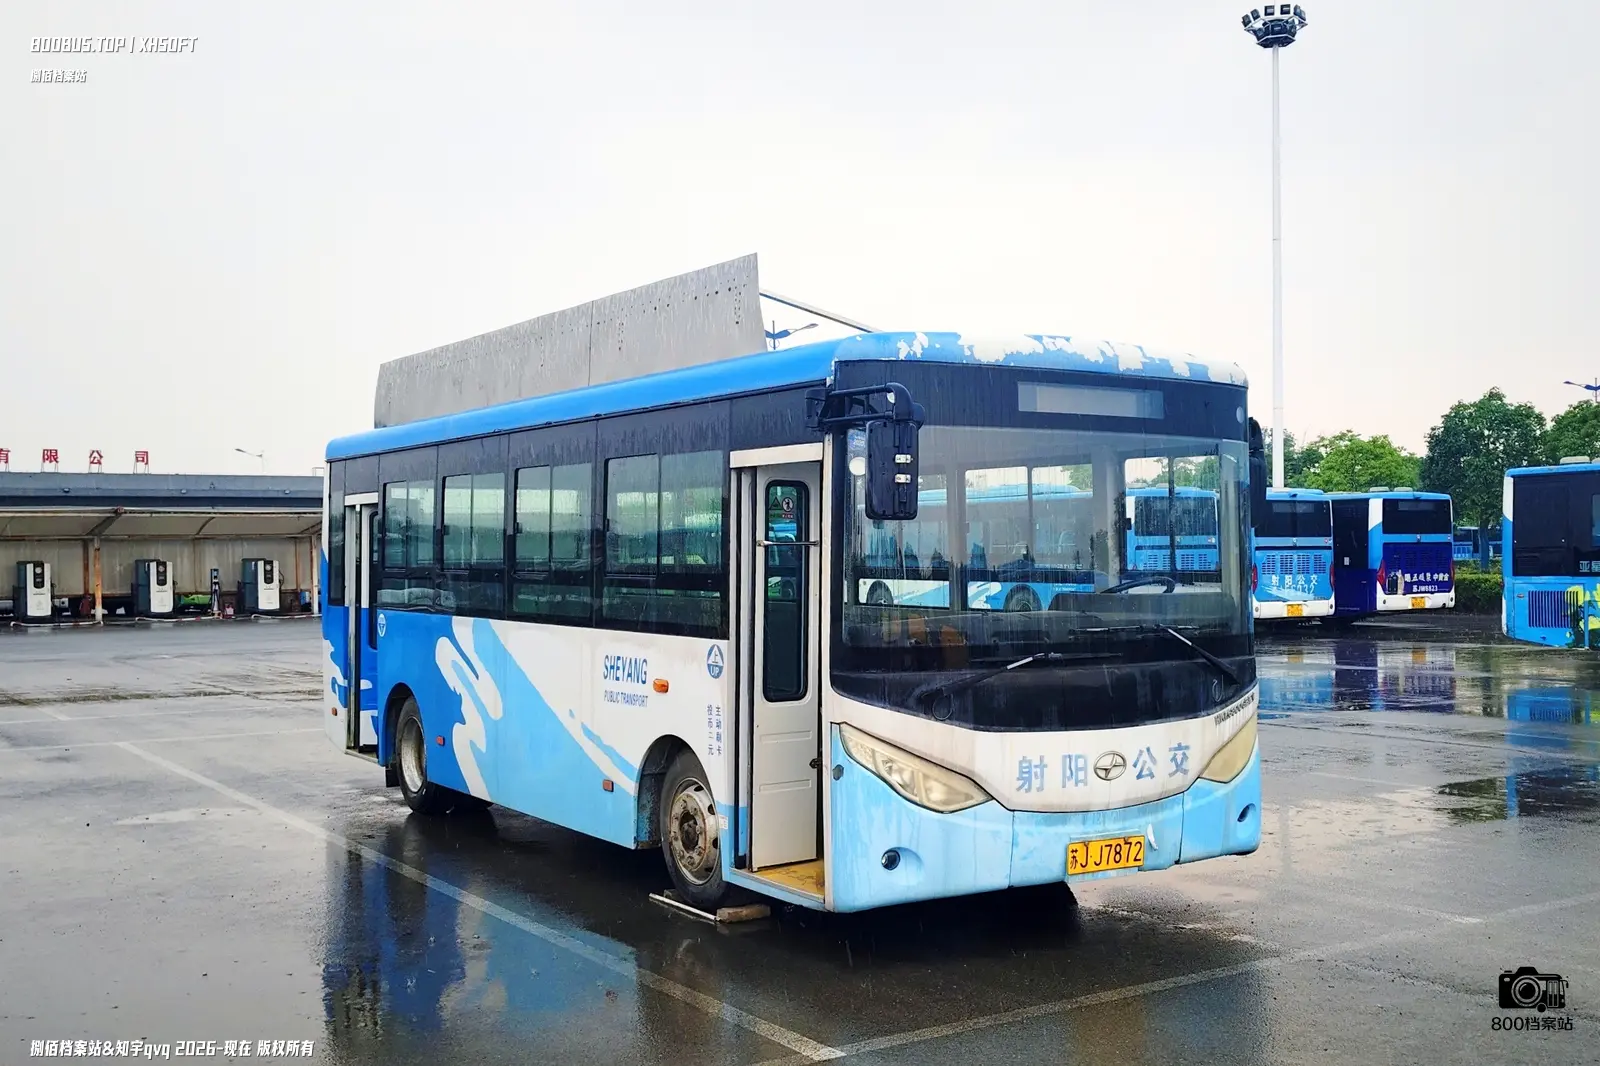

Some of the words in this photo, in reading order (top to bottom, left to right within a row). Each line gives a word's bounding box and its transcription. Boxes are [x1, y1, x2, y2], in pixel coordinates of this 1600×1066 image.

[0, 448, 149, 465] 有限公司
[1271, 573, 1318, 586] 射阳公交
[711, 650, 719, 664] 上
[603, 654, 648, 685] SHEYANG
[710, 665, 720, 677] UP
[604, 690, 620, 704] PUBLIC
[620, 692, 648, 708] TRANSPORT
[706, 704, 714, 756] 投币二元
[1016, 742, 1191, 793] 射阳公交
